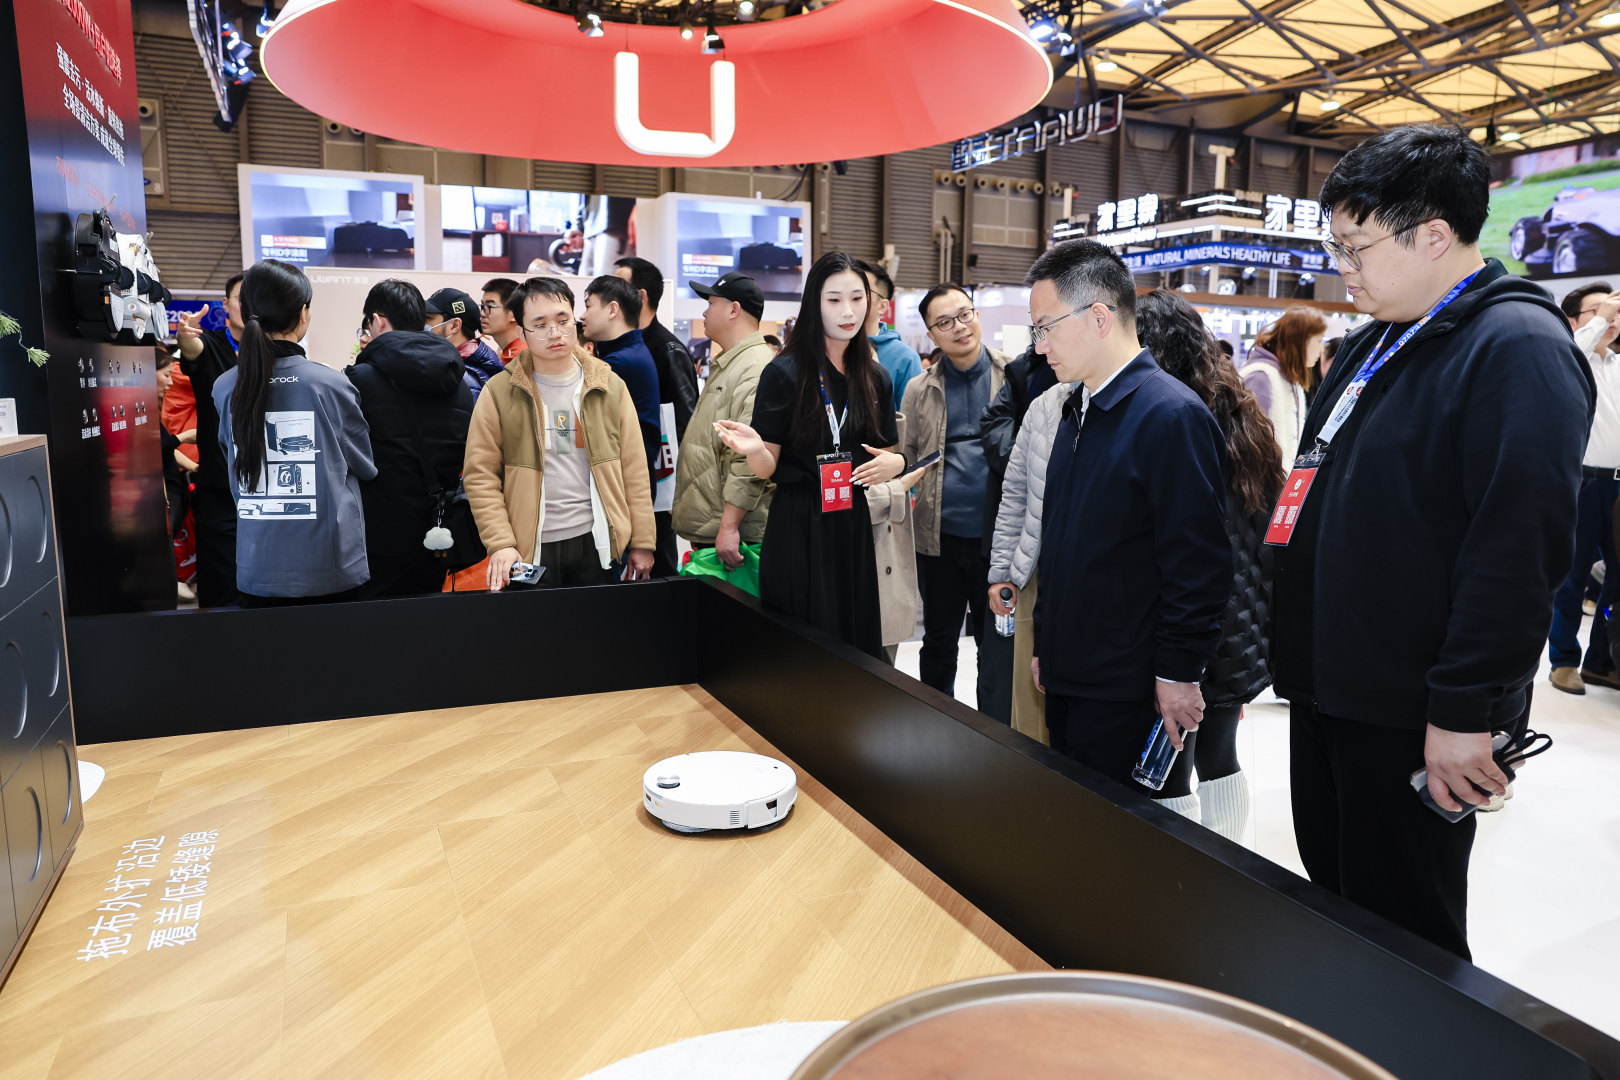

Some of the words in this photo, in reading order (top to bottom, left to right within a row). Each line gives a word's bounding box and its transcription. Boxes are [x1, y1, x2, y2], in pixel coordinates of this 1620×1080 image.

[614, 51, 736, 158] U
[1144, 250, 1184, 266] NATURAL
[1184, 245, 1230, 261] MINERALS
[1230, 246, 1272, 263] HEALTHY
[1272, 251, 1292, 266] LIFE
[76, 835, 165, 962] 拖布外扩沿边
[146, 829, 219, 951] 覆盖低矮缝隙
